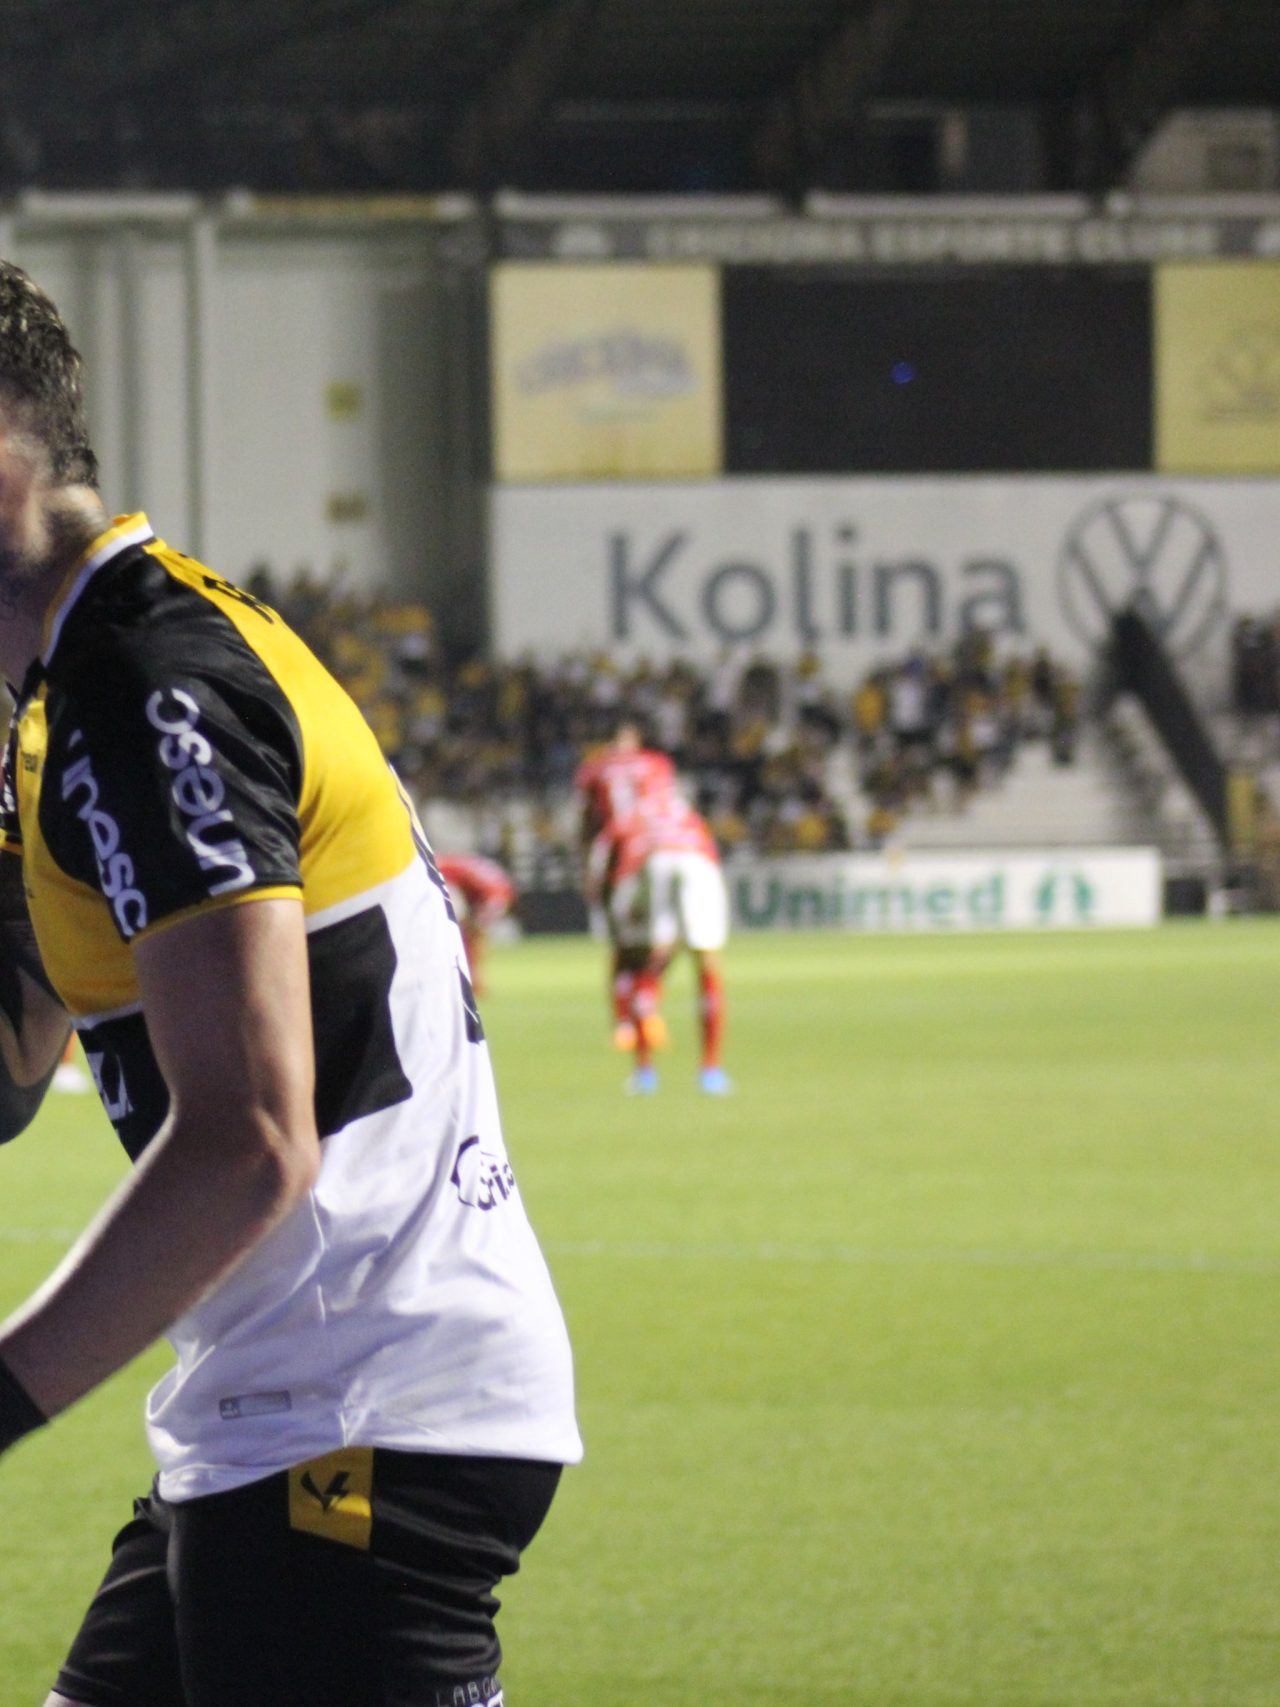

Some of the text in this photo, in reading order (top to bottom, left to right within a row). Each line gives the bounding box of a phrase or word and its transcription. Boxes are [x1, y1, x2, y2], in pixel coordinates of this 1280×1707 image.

[609, 523, 1025, 641] Kolina
[61, 730, 147, 937] nesc
[146, 687, 255, 896] unesc
[734, 872, 1005, 927] Unimed
